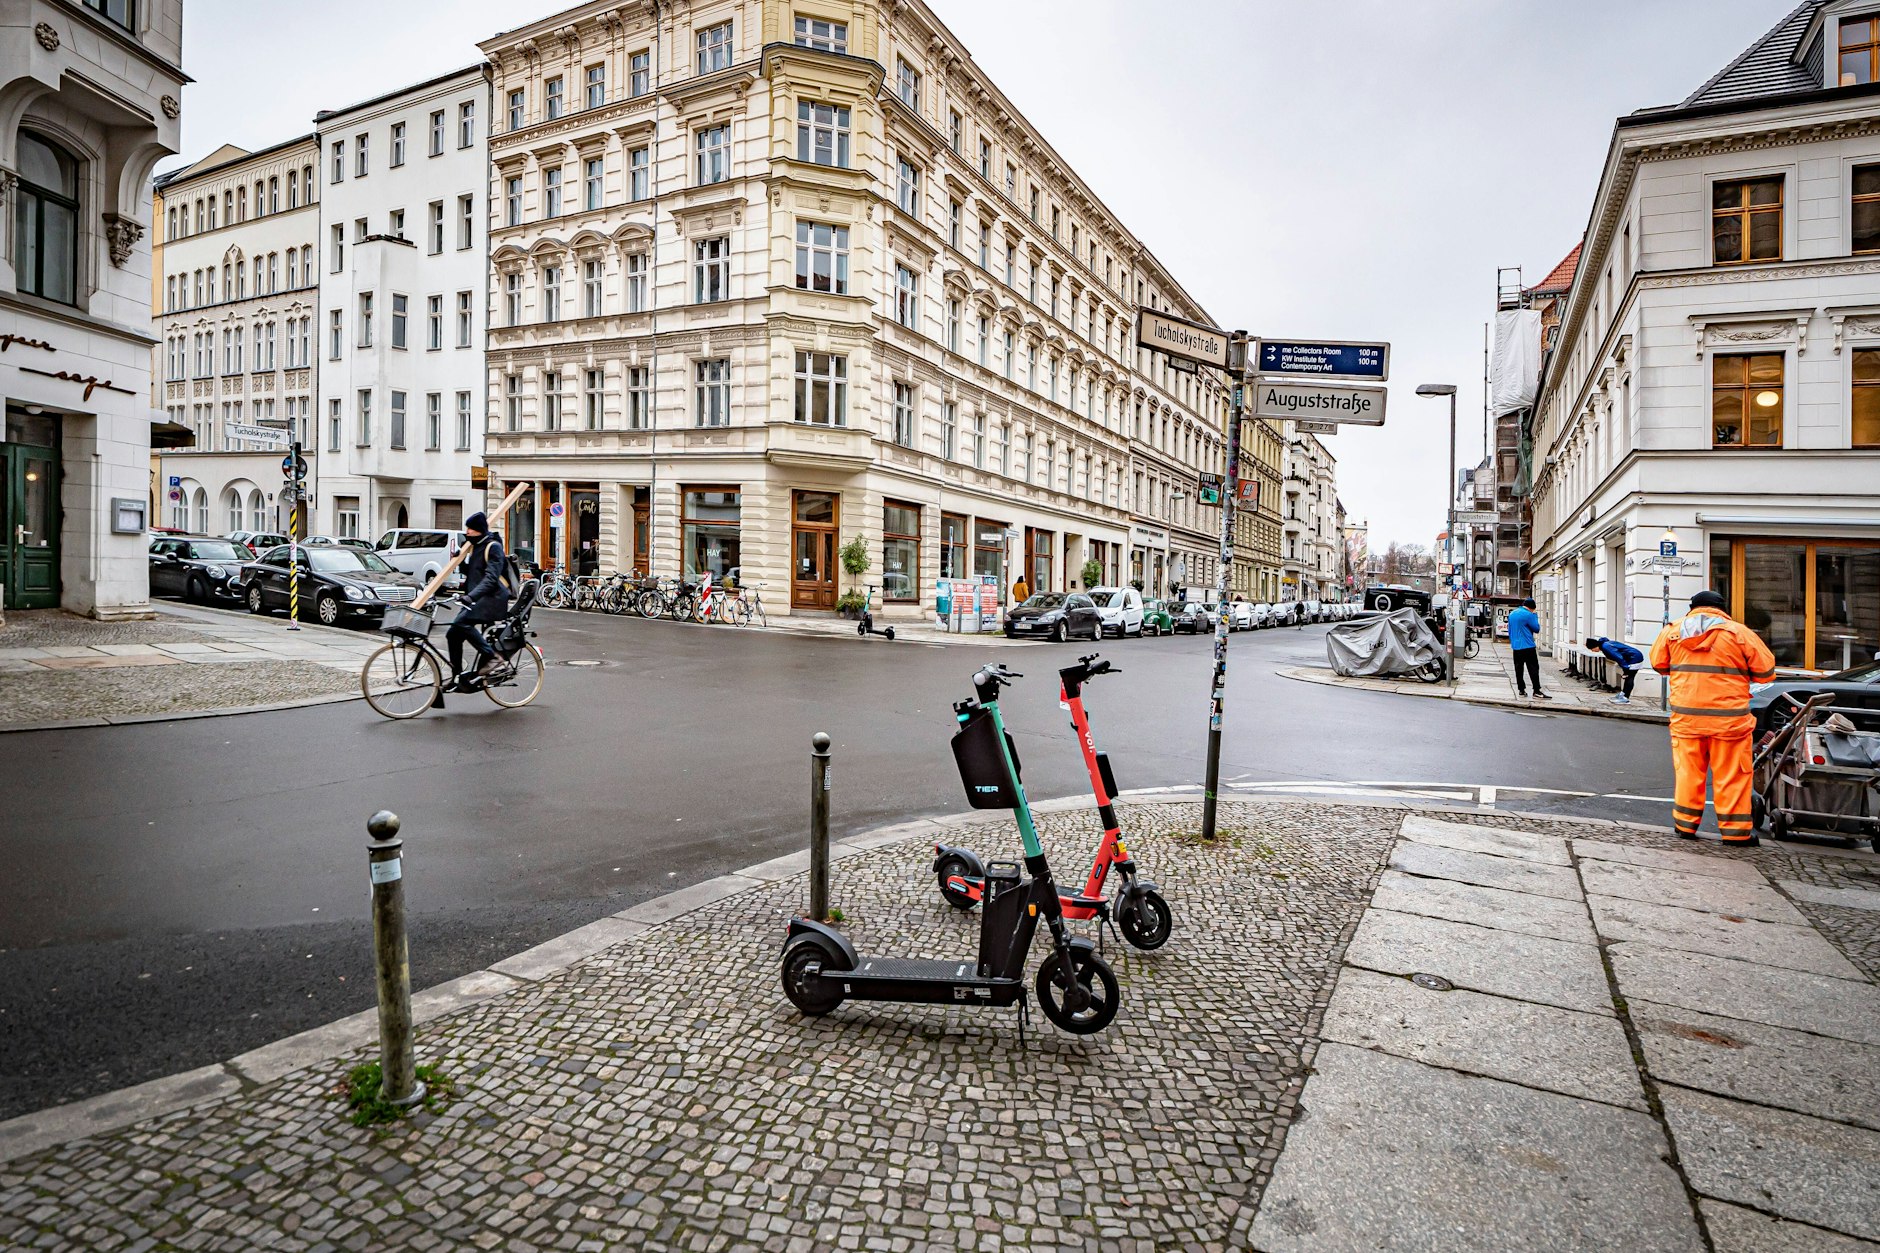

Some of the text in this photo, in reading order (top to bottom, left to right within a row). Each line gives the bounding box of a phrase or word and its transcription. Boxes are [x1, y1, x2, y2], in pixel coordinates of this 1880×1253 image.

[1154, 319, 1218, 355] Tucholskystraße
[1293, 346, 1322, 354] Collectors
[1323, 347, 1342, 355] Room
[1294, 355, 1317, 363] Institute
[1281, 362, 1322, 372] Contemporary
[1265, 388, 1371, 415] Auguststraße
[233, 426, 281, 440] Tucholskystraße
[706, 548, 720, 557] HAY
[892, 561, 903, 569] HAY
[989, 880, 997, 903] TIER
